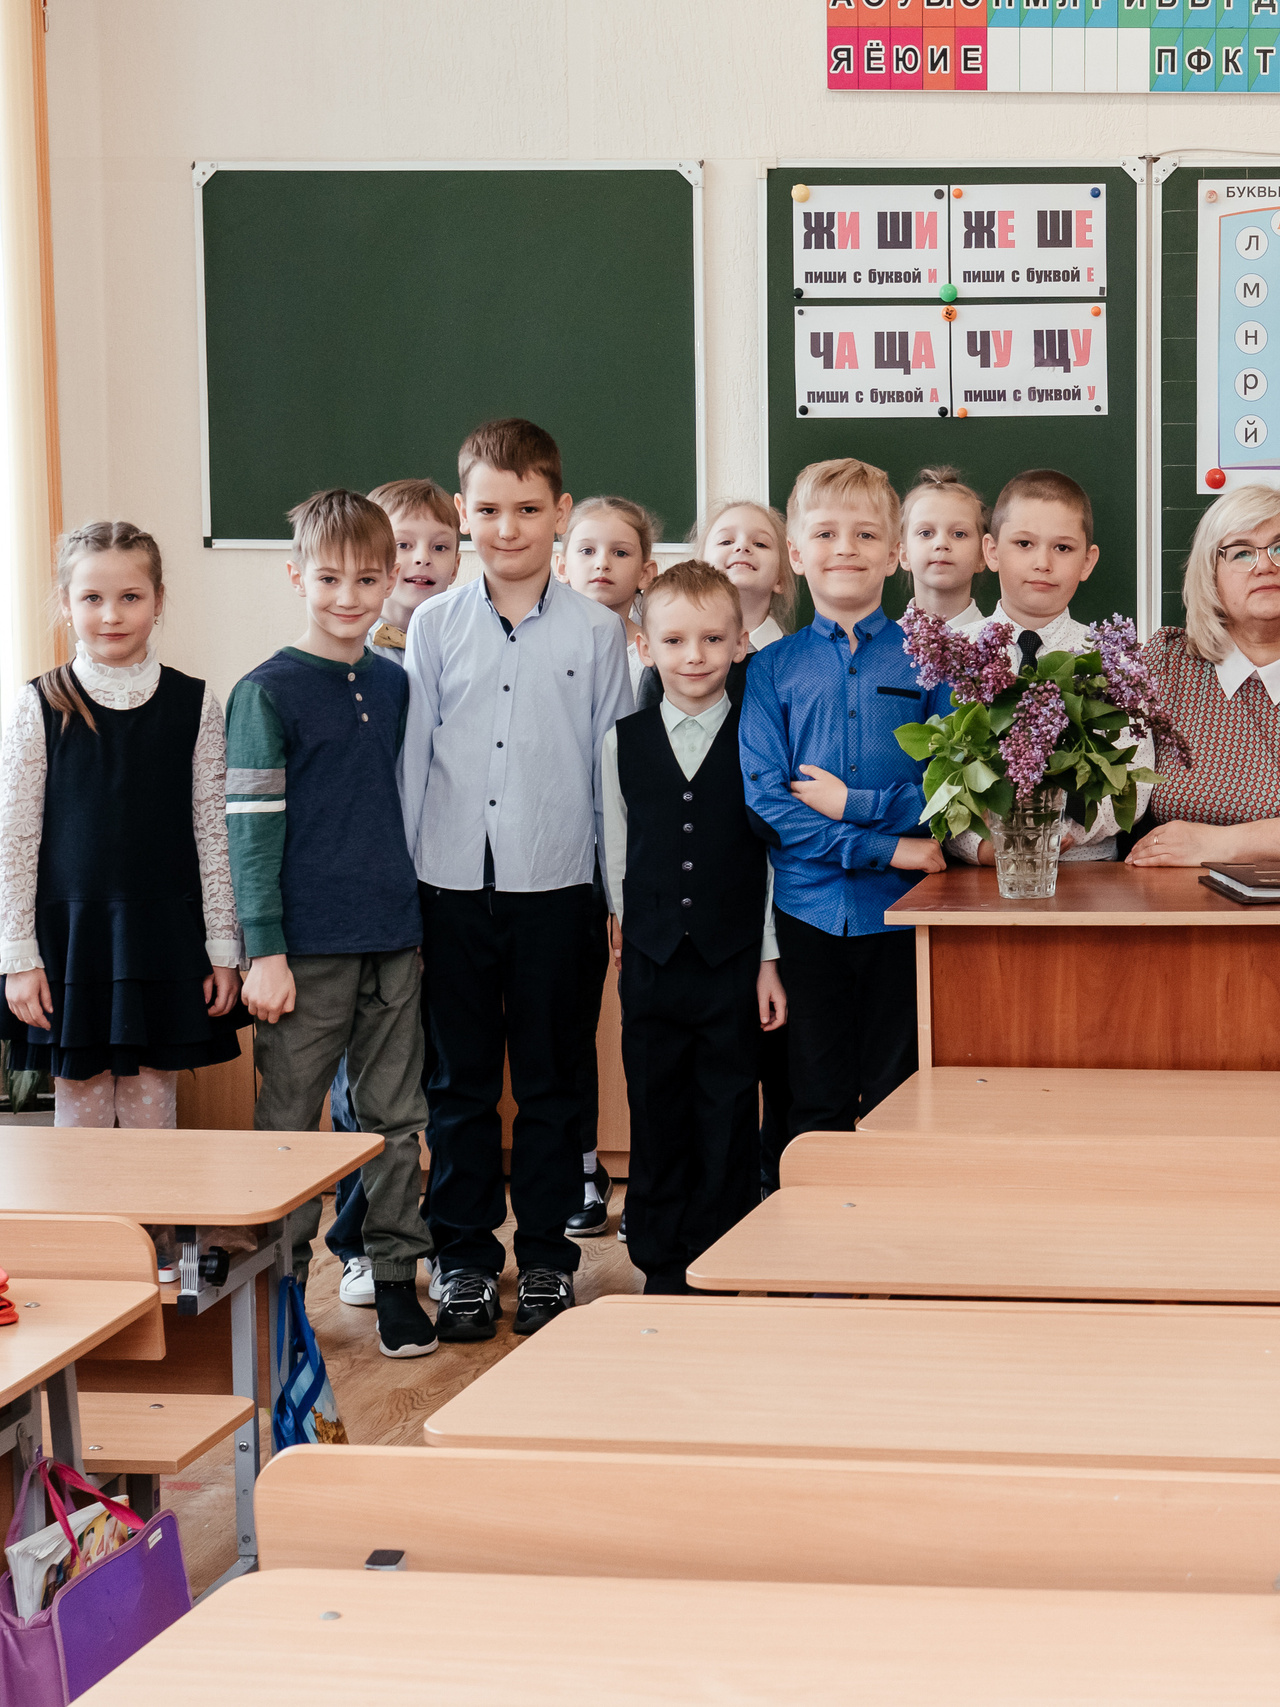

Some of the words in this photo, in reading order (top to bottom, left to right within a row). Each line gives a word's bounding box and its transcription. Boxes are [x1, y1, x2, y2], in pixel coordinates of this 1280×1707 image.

[802, 211, 861, 250] ЖИ
[876, 210, 938, 250] ШИ
[962, 210, 1016, 249] ЖЕ
[1036, 209, 1094, 249] ШЕ
[804, 270, 847, 284] пиши
[853, 270, 863, 284] с
[867, 267, 922, 285] буквой
[927, 268, 938, 284] И
[962, 269, 1006, 284] пиши
[1010, 269, 1021, 283] с
[1025, 266, 1081, 284] буквой
[1086, 266, 1095, 283] Е
[809, 331, 860, 370] ЧА
[873, 330, 936, 376] ЩА
[966, 329, 1013, 369] ЧУ
[1032, 328, 1093, 374] ЩУ
[806, 390, 849, 404] пиши
[854, 390, 864, 404] с
[869, 387, 924, 405] буквой
[929, 387, 940, 403] А
[963, 388, 1007, 403] пиши
[1012, 388, 1022, 403] с
[1027, 384, 1082, 404] буквой
[1086, 385, 1096, 401] У
